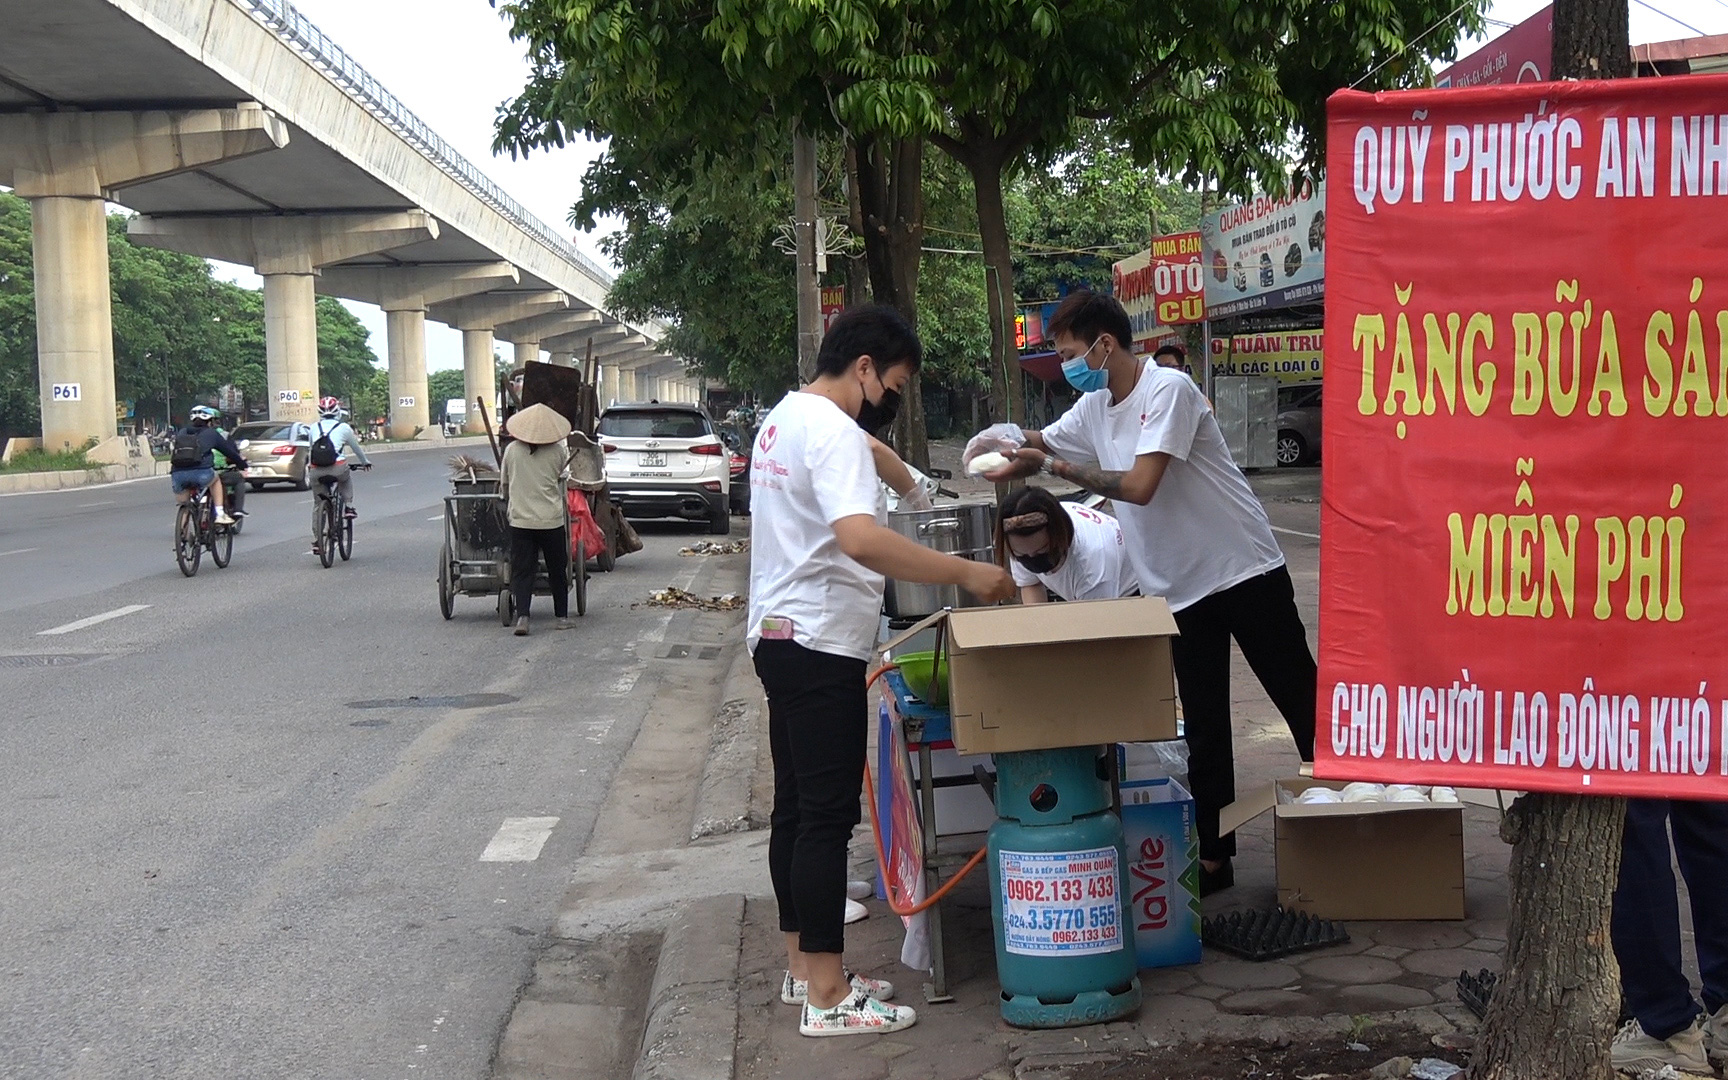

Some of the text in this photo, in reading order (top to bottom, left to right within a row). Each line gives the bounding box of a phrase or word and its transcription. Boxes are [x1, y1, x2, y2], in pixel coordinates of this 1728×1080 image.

[1353, 99, 1728, 214] QUỸ PHƯỚC AN NH
[1152, 234, 1202, 257] MUA BÁN
[1154, 256, 1204, 296] ÔTÔ
[1160, 295, 1203, 322] CŨ
[1241, 358, 1269, 374] CÁC
[1274, 360, 1305, 374] LOẠI
[1310, 358, 1320, 371] Ô
[1352, 281, 1497, 440] TẶNG
[1510, 278, 1628, 417] BỮA
[54, 386, 78, 398] P61
[280, 392, 298, 401] P60
[1445, 457, 1686, 622] MIỄN PHÍ
[1331, 681, 1388, 758] CHO
[1396, 668, 1483, 764] NGƯỜI
[1493, 690, 1548, 768] LAO
[1557, 676, 1640, 785] ĐỘNG
[1649, 681, 1710, 776] KHÓ
[1041, 866, 1053, 874] BẾP
[1068, 862, 1092, 873] MINH
[1094, 858, 1113, 872] QUÂN
[1007, 876, 1113, 902] 0962.133 433
[1090, 904, 1115, 928] 555
[1052, 930, 1098, 943] 0962.133
[1102, 926, 1116, 939] 433
